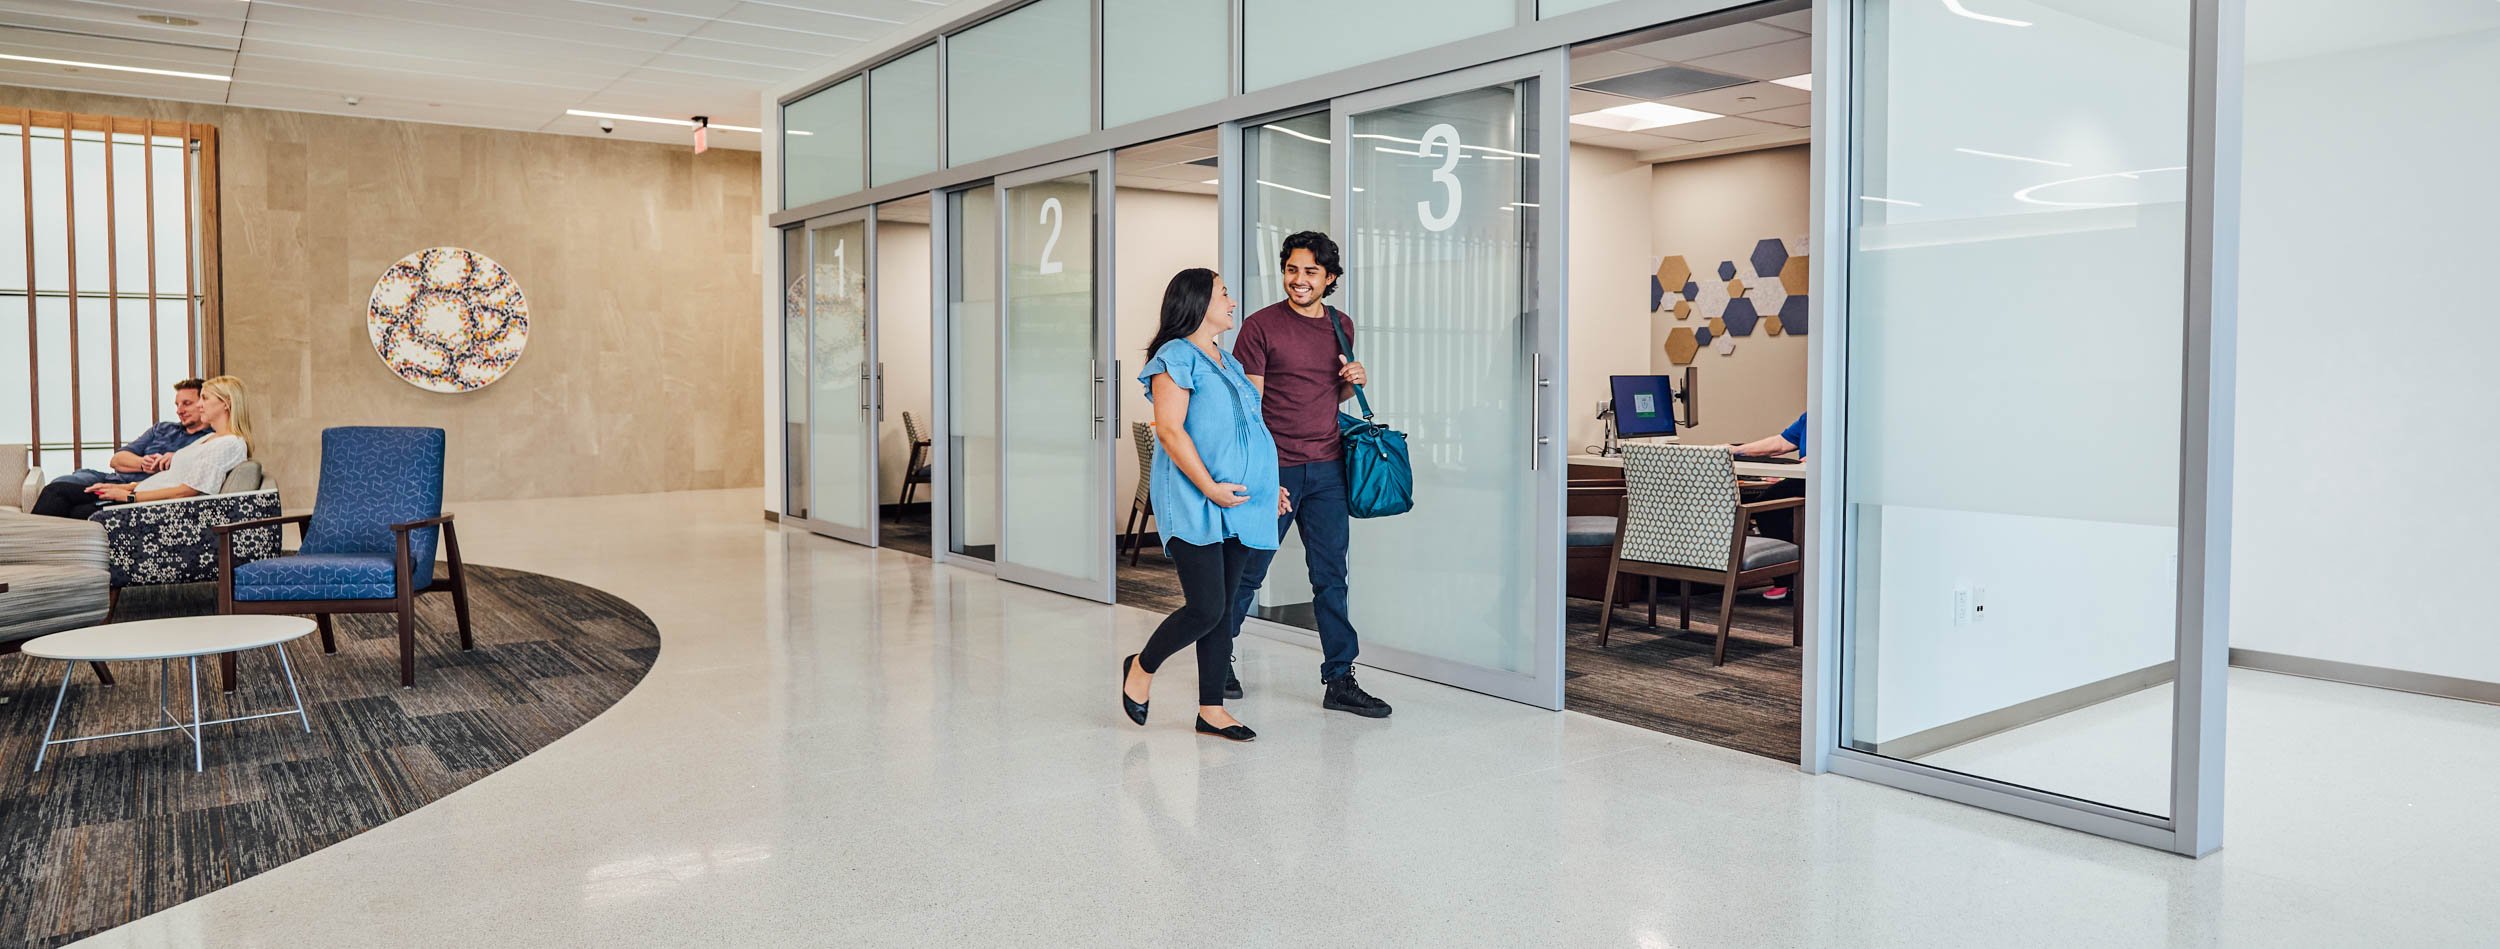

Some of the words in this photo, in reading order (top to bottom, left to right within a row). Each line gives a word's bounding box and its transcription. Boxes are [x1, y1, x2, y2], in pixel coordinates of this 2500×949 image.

[1417, 123, 1462, 232] 3
[833, 238, 845, 299] 1
[1039, 197, 1063, 276] 2
